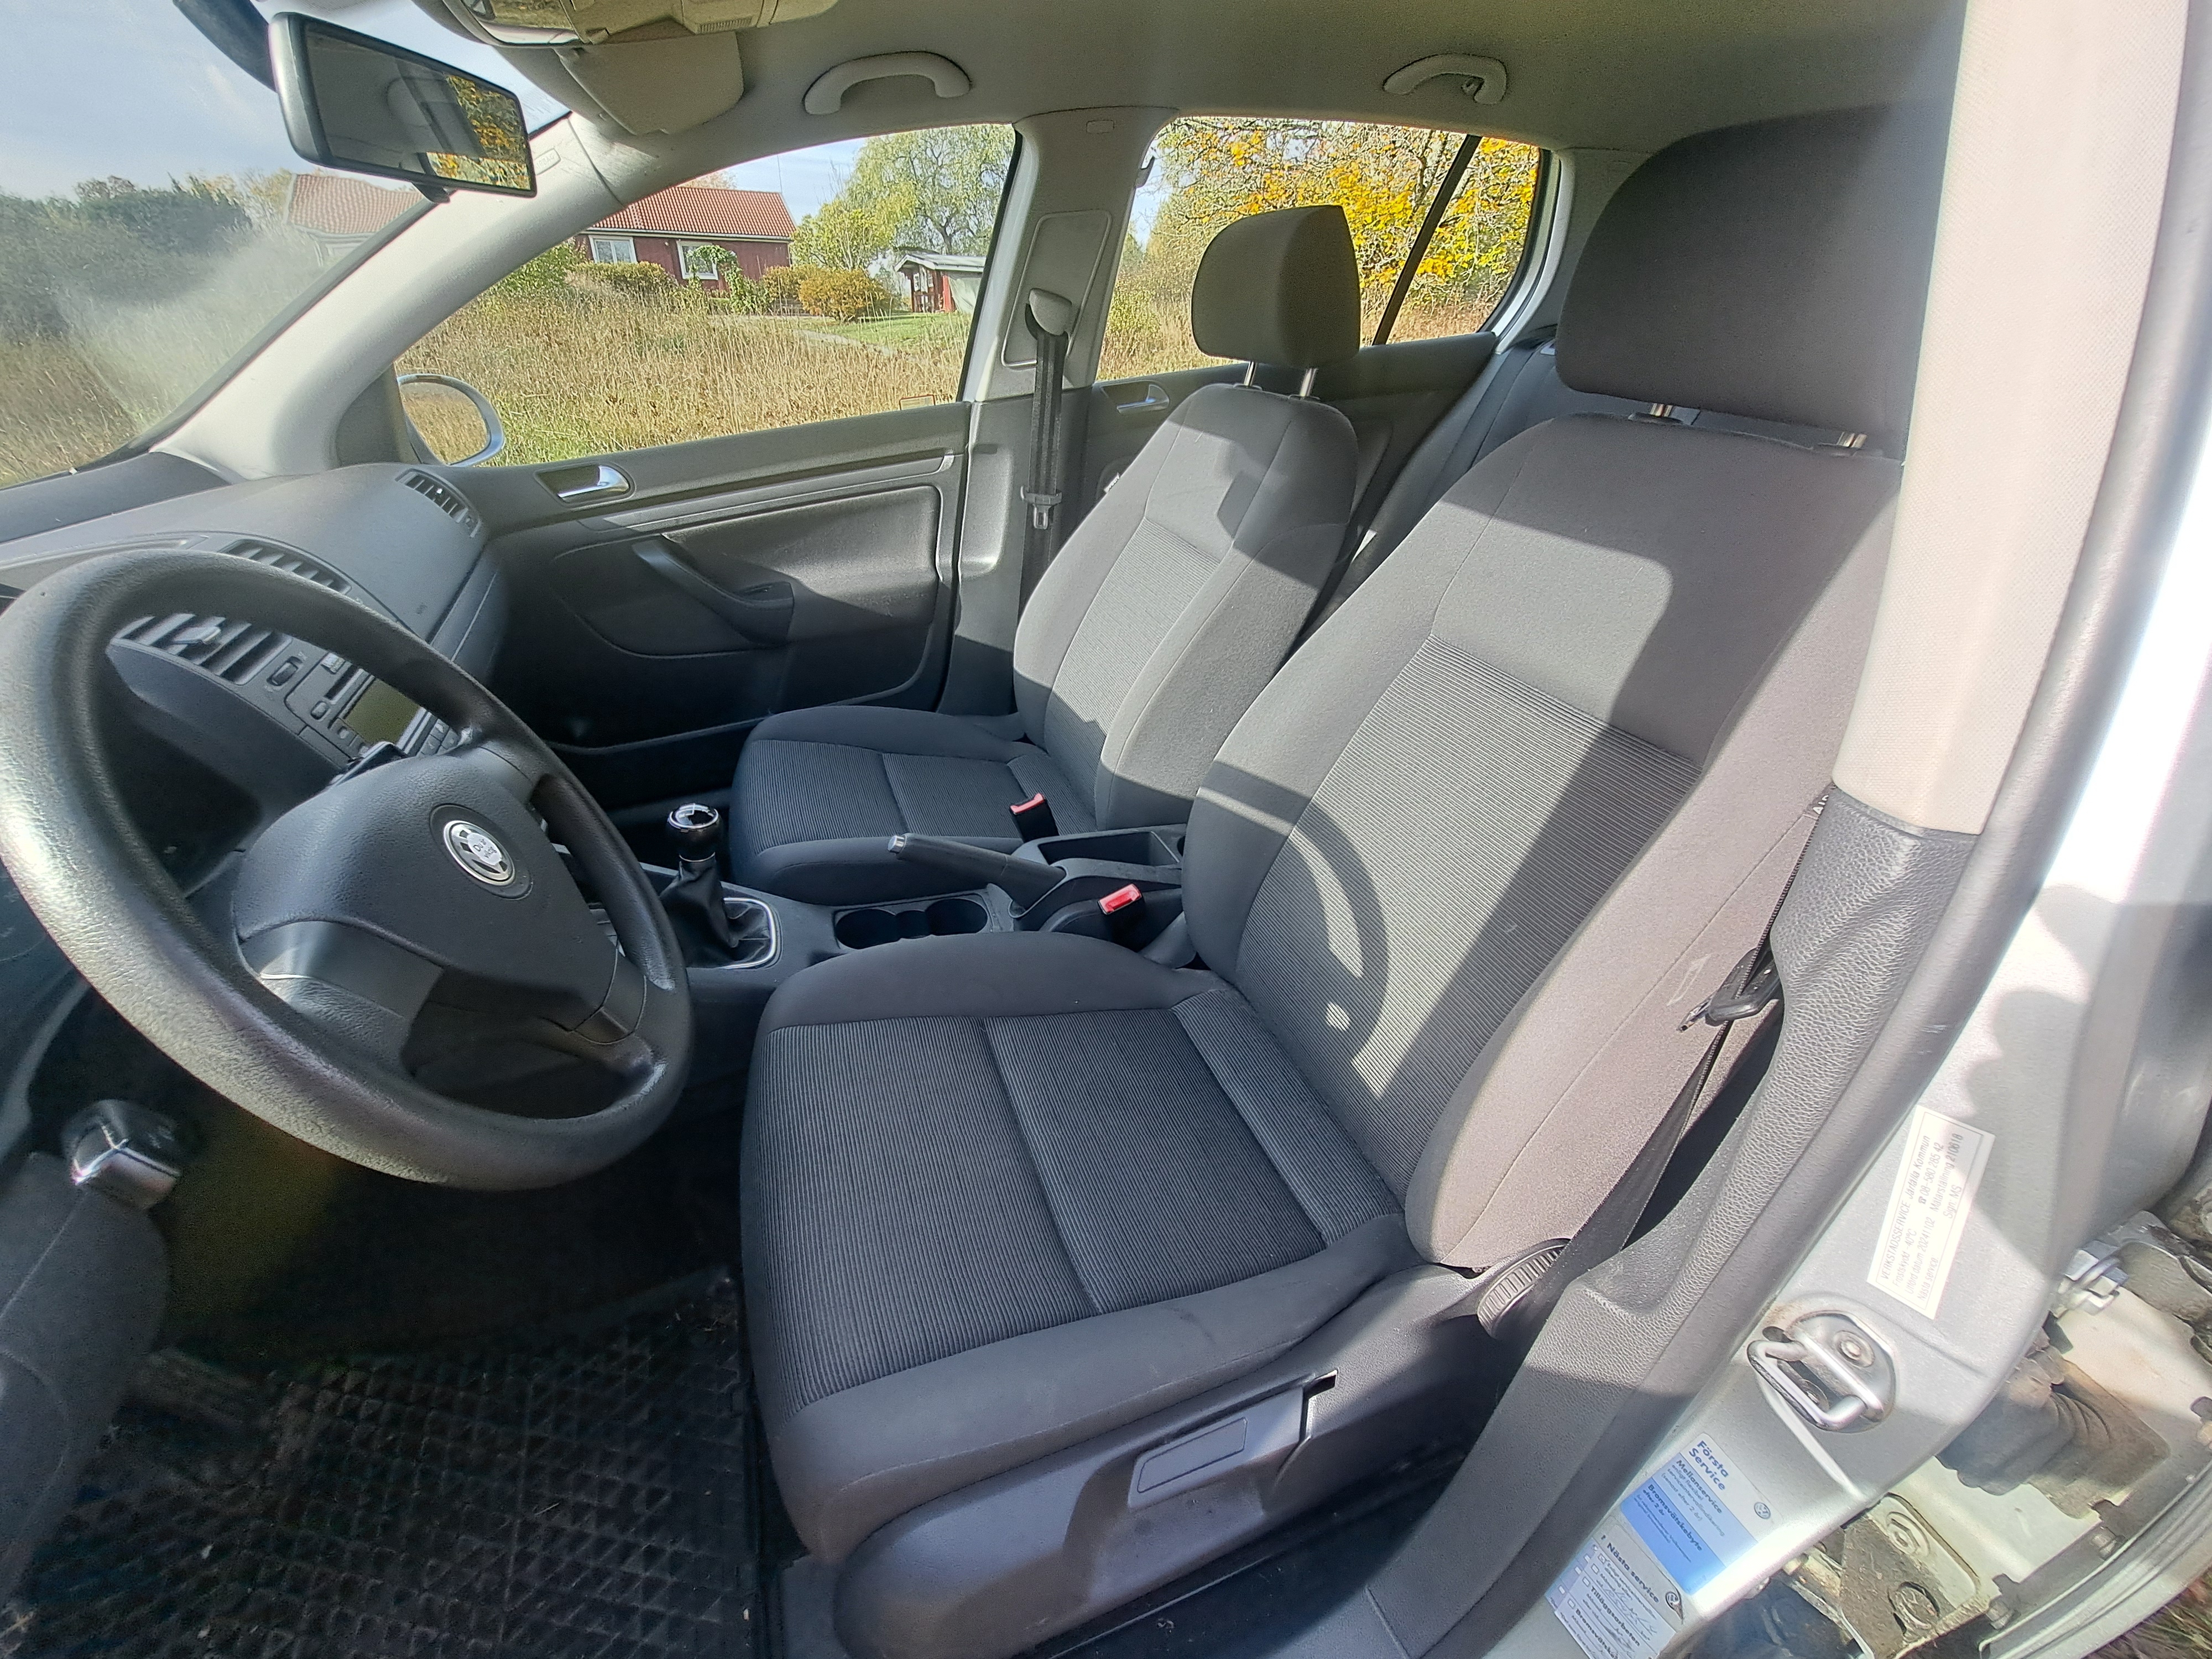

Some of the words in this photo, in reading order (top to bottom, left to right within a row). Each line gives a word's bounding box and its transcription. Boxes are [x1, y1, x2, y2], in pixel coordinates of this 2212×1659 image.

[1929, 1153, 1939, 1167] 285
[1933, 1142, 1943, 1152] 42
[1920, 1168, 1935, 1195] 08-580
[1950, 1185, 1960, 1198] MS
[1881, 1201, 1910, 1279] VERKSTADSSERVICE
[1913, 1135, 1930, 1168] Kommun
[1917, 1218, 1934, 1251] 20241102
[1911, 1253, 1924, 1273] datum
[1689, 1447, 1726, 1490] Service
[1697, 1441, 1729, 1477] Första
[1676, 1460, 1722, 1513] Mellanservice
[1648, 1485, 1702, 1551] Bromsvätskebyte
[1606, 1543, 1630, 1571] Nästa
[1630, 1571, 1660, 1603] service
